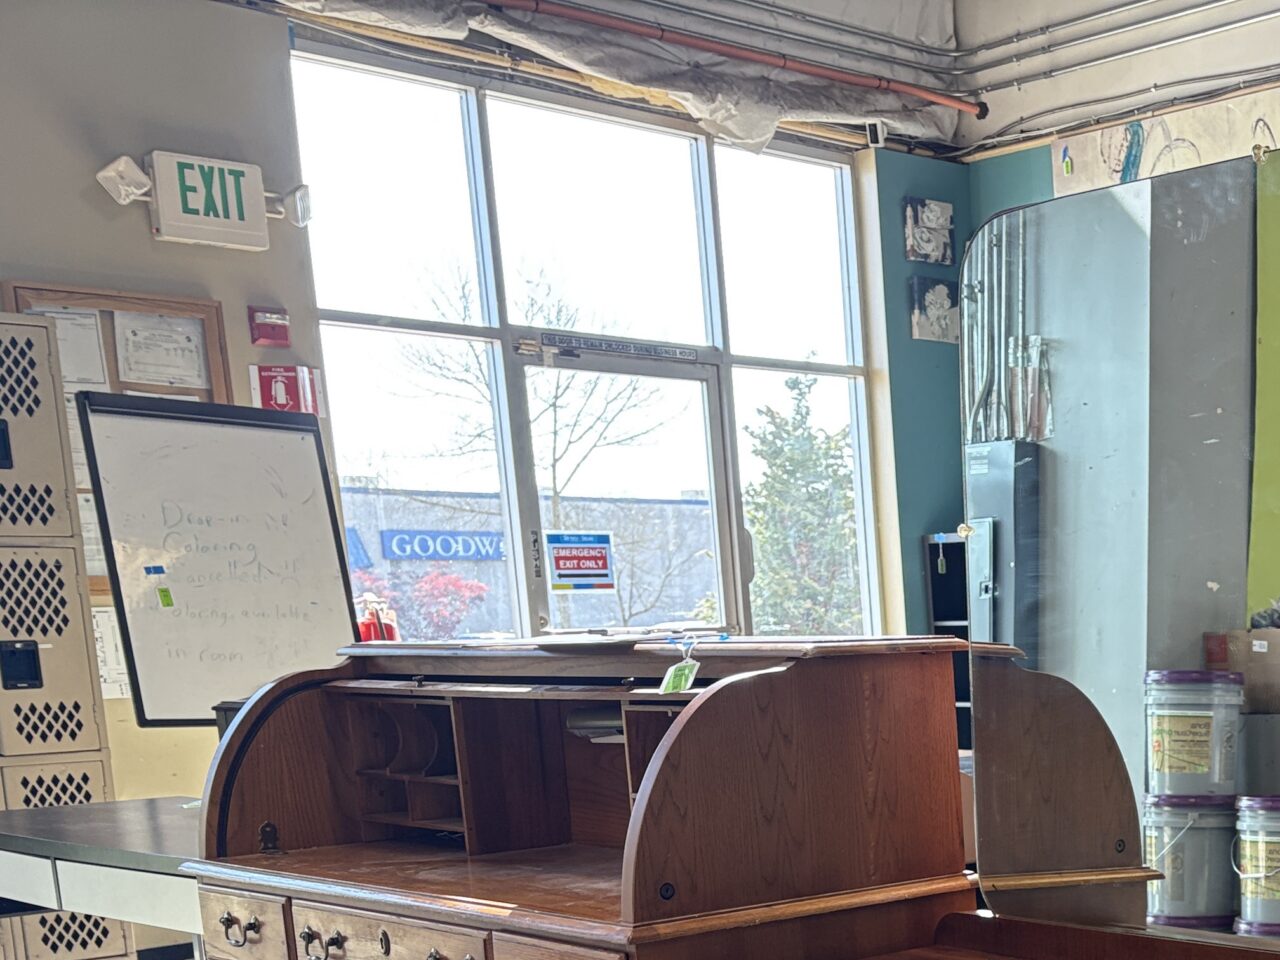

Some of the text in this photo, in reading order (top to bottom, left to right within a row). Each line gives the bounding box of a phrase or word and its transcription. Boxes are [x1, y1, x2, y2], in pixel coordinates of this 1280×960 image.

[176, 161, 246, 222] EXIT
[582, 338, 604, 350] REMAIN
[604, 340, 632, 353] UNLOCKED
[632, 343, 653, 355] DURING
[653, 346, 678, 357] BUSINESS
[678, 348, 696, 359] HOURS
[391, 534, 504, 557] GOODW
[553, 548, 607, 557] EMERGENCY
[559, 560, 604, 568] EXIT ONLY
